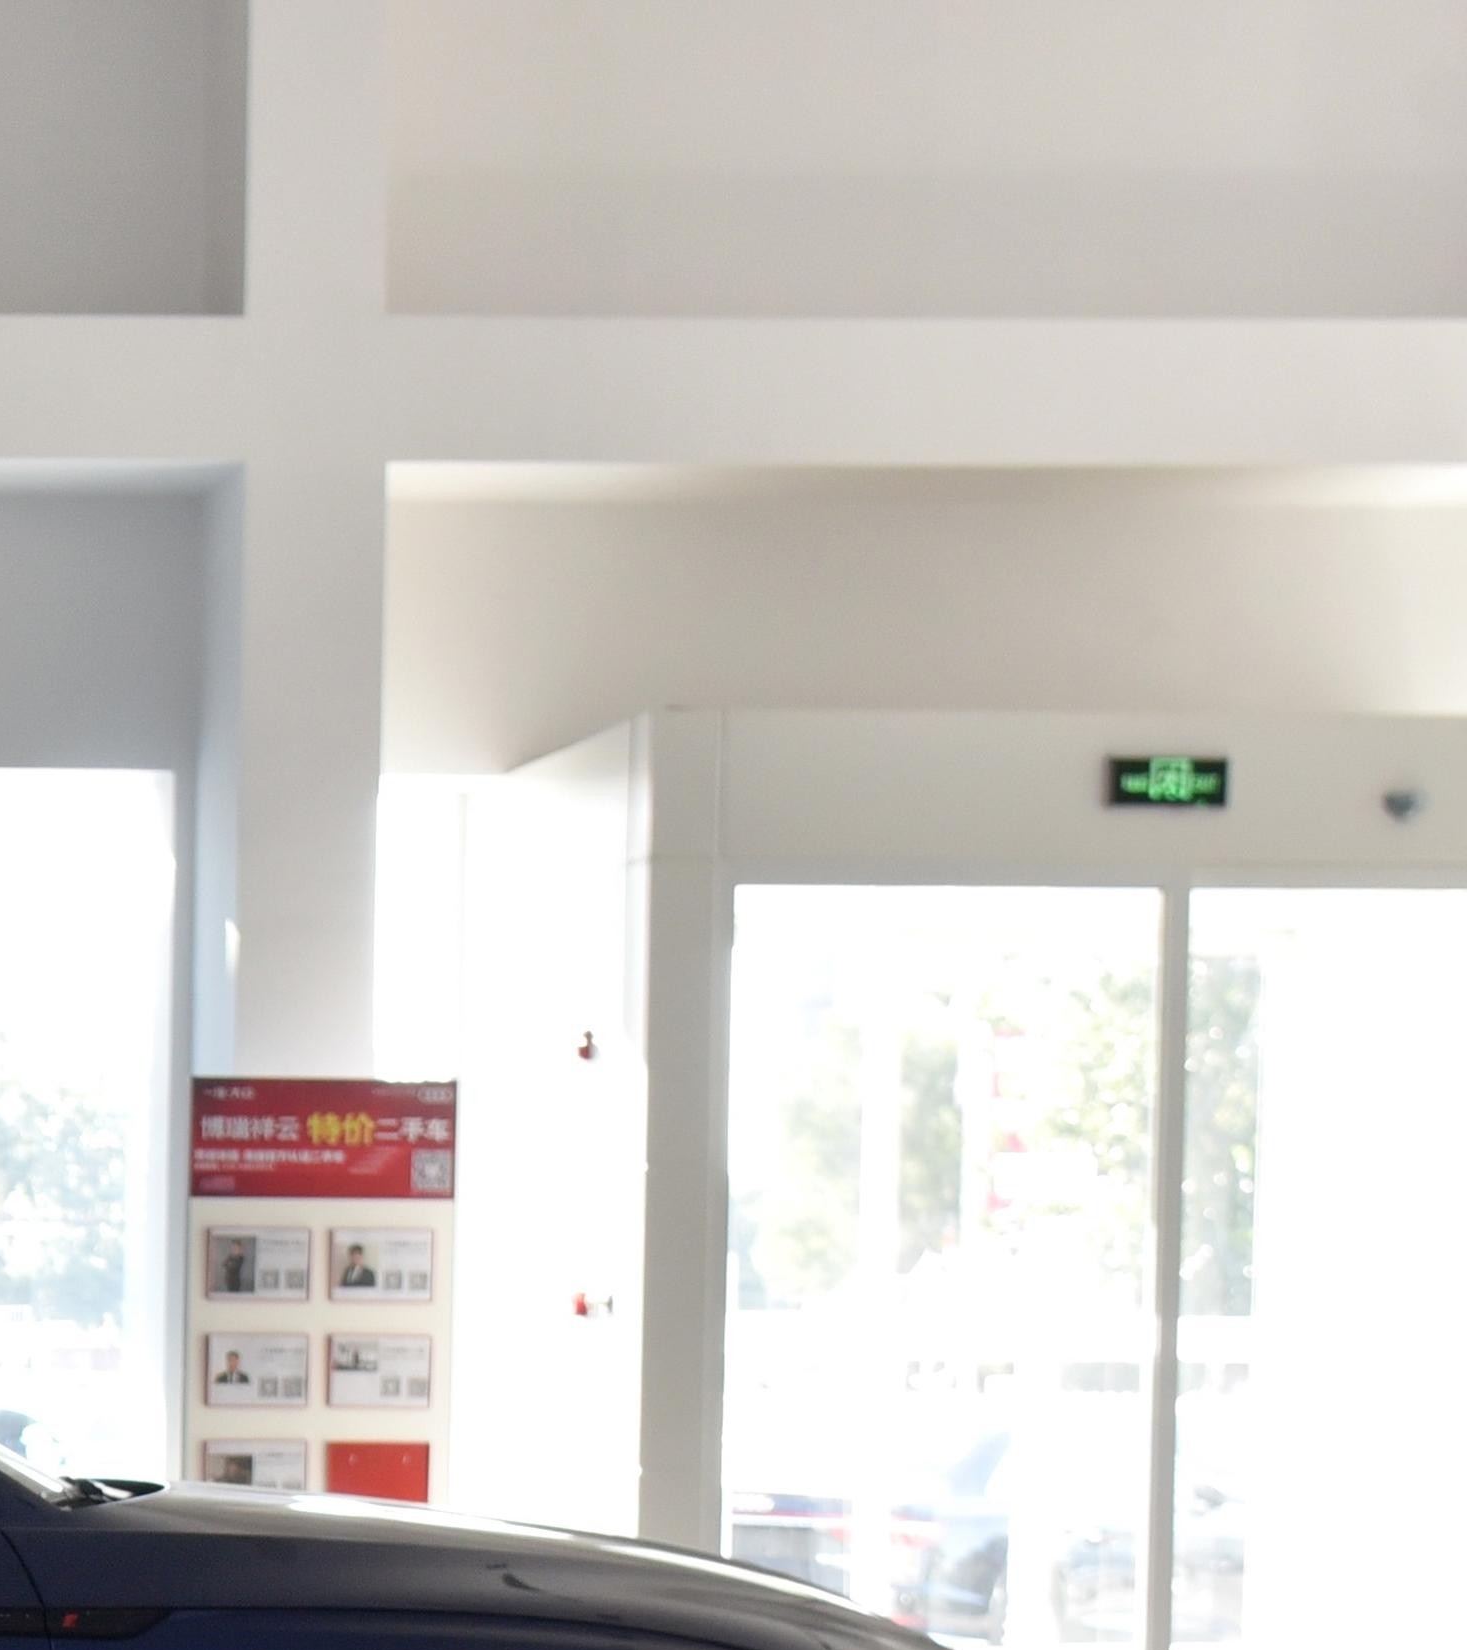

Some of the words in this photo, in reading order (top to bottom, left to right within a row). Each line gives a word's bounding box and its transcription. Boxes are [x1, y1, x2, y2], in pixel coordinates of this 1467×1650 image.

[201, 1115, 300, 1141] 博瑞祥云
[306, 1111, 450, 1146] 特价二手车
